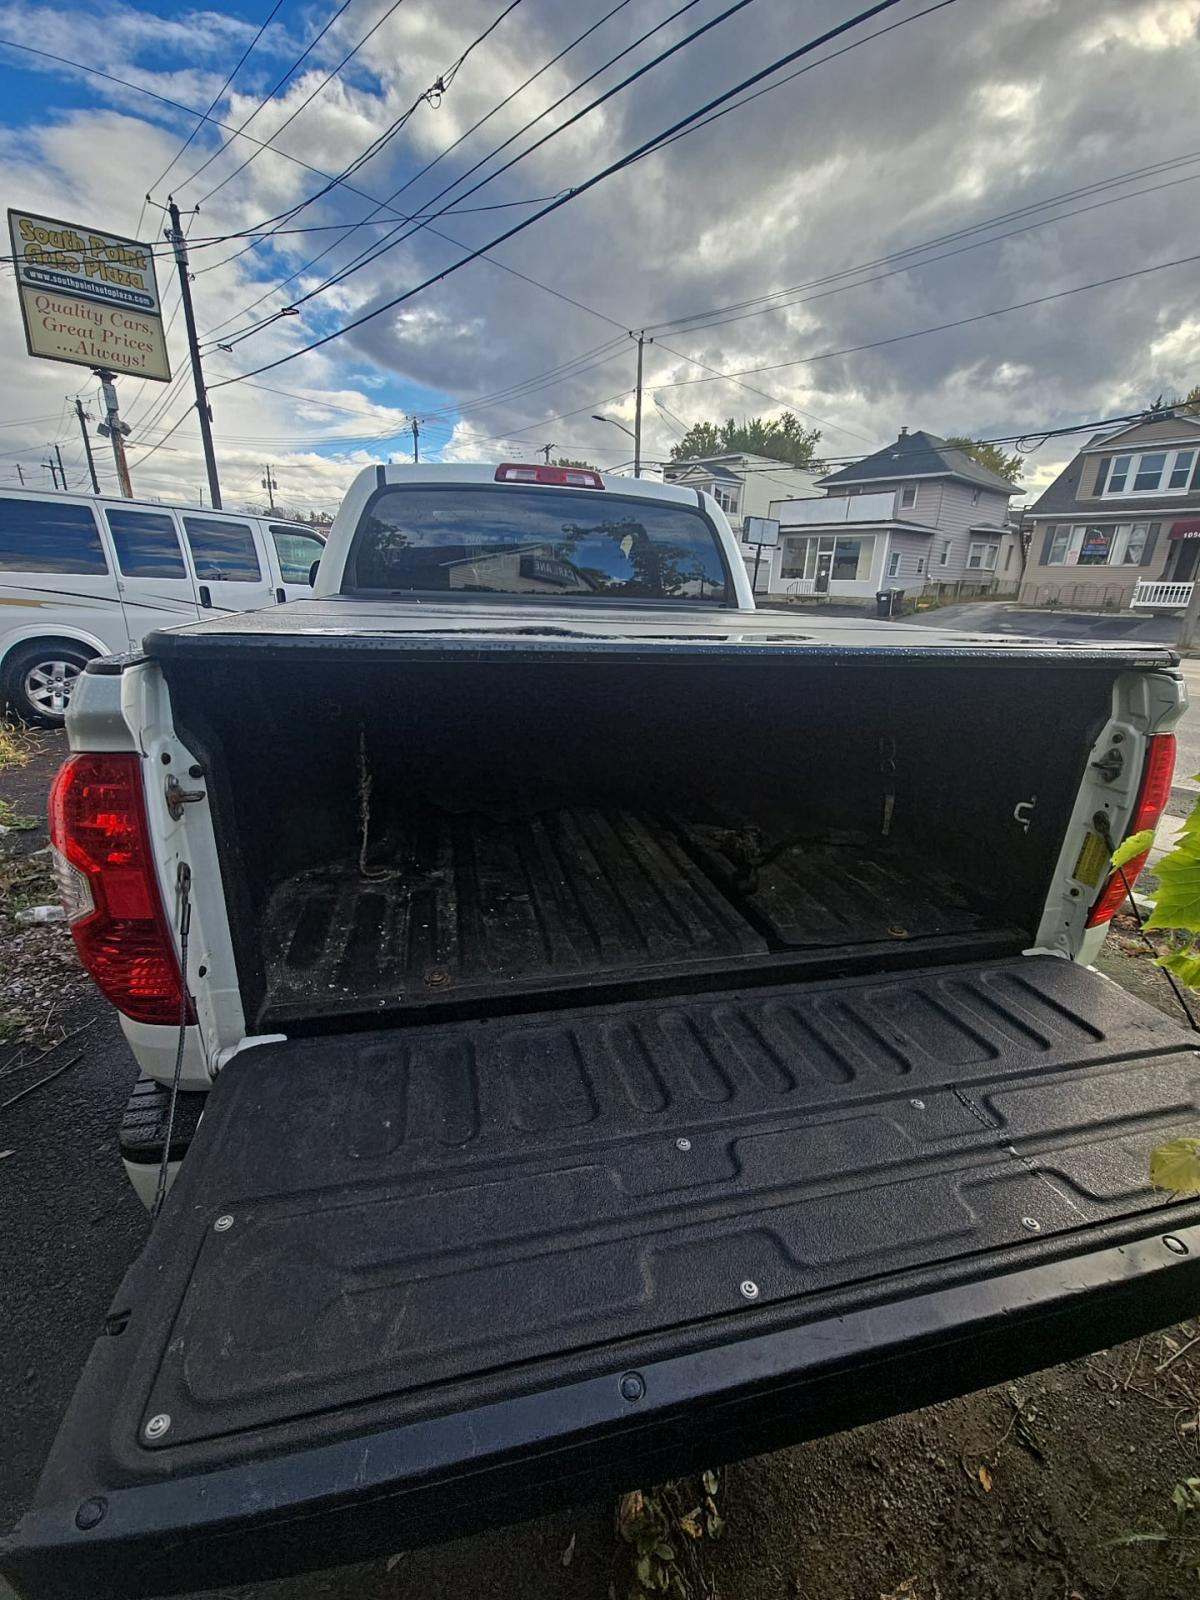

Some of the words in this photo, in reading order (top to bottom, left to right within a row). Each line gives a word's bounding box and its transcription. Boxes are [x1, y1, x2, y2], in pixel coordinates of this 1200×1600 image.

[18, 219, 85, 253] South
[89, 236, 147, 270] Point
[29, 271, 151, 305] www.southpointautoplaza.com
[83, 256, 145, 290] Plaza
[35, 295, 103, 325] Quality
[42, 316, 95, 339] Great
[102, 329, 153, 352] Prices
